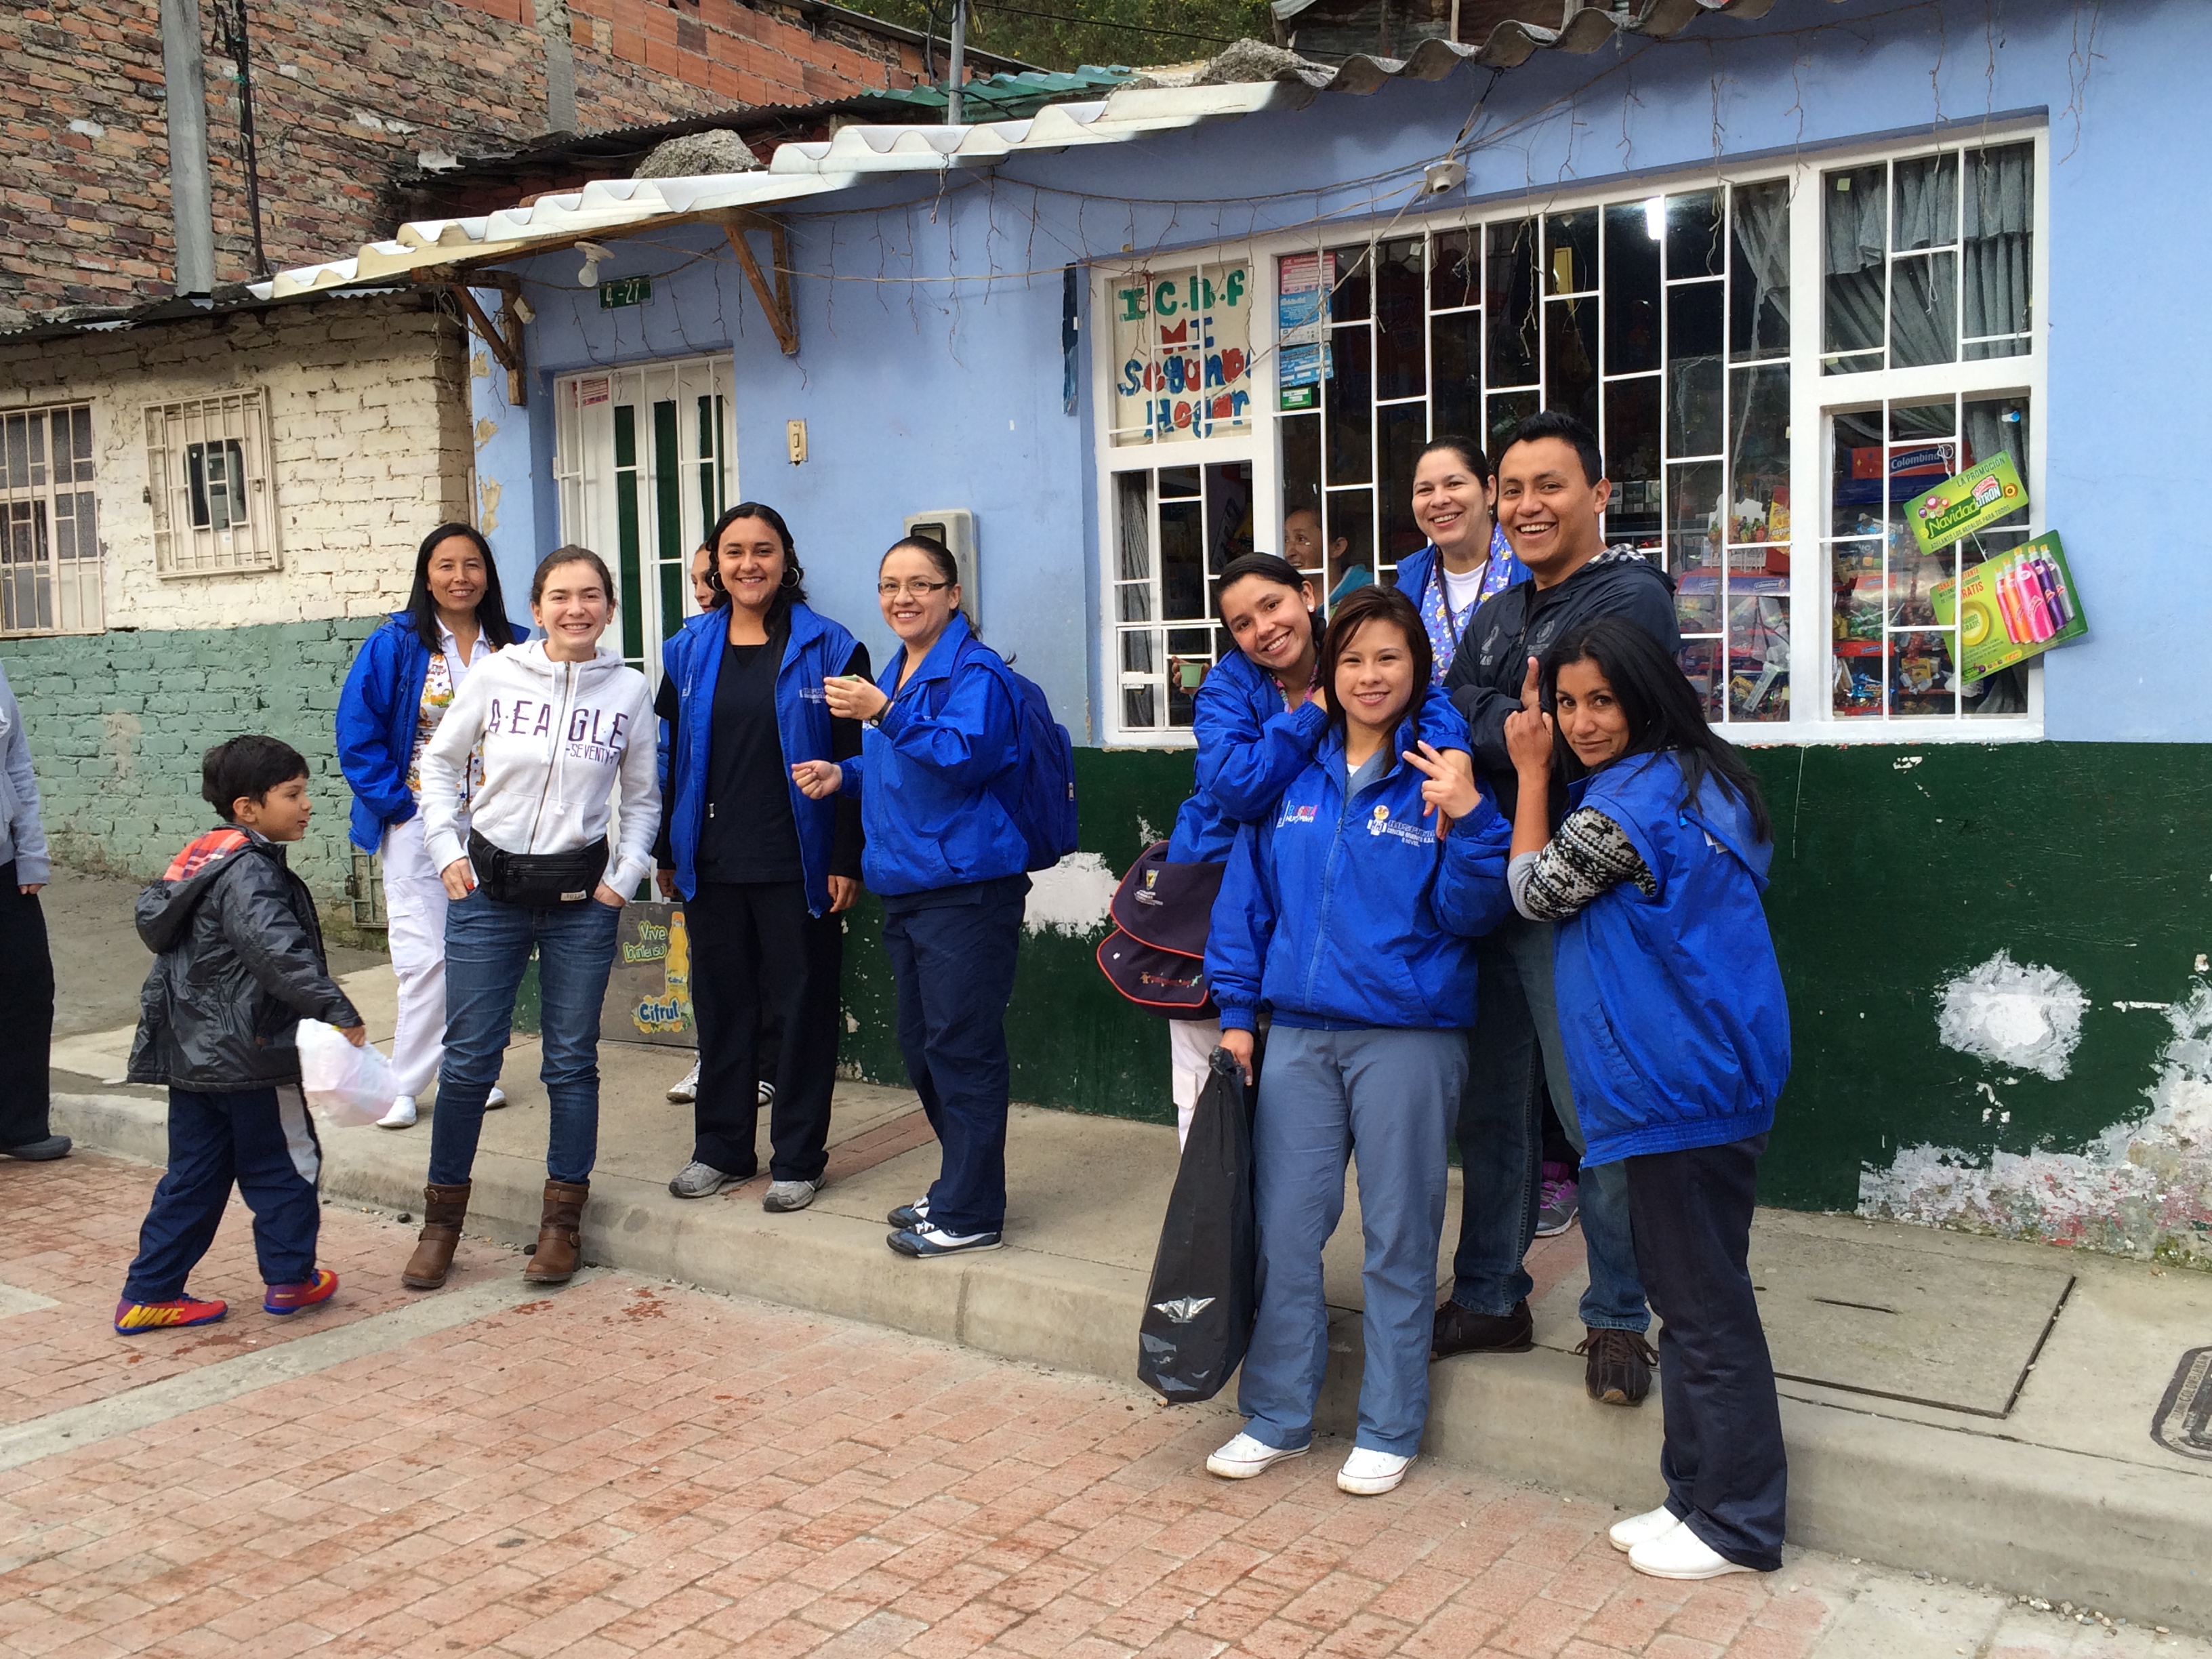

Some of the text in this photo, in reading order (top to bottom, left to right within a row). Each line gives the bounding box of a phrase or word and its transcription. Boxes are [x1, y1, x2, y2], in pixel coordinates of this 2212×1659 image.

[1957, 477, 1966, 487] LA
[1929, 497, 1978, 537] Navidad
[1961, 581, 1984, 600] RATIS
[640, 924, 666, 941] Vive
[640, 1000, 679, 1022] Cifrut
[118, 1305, 185, 1327] NIKE
